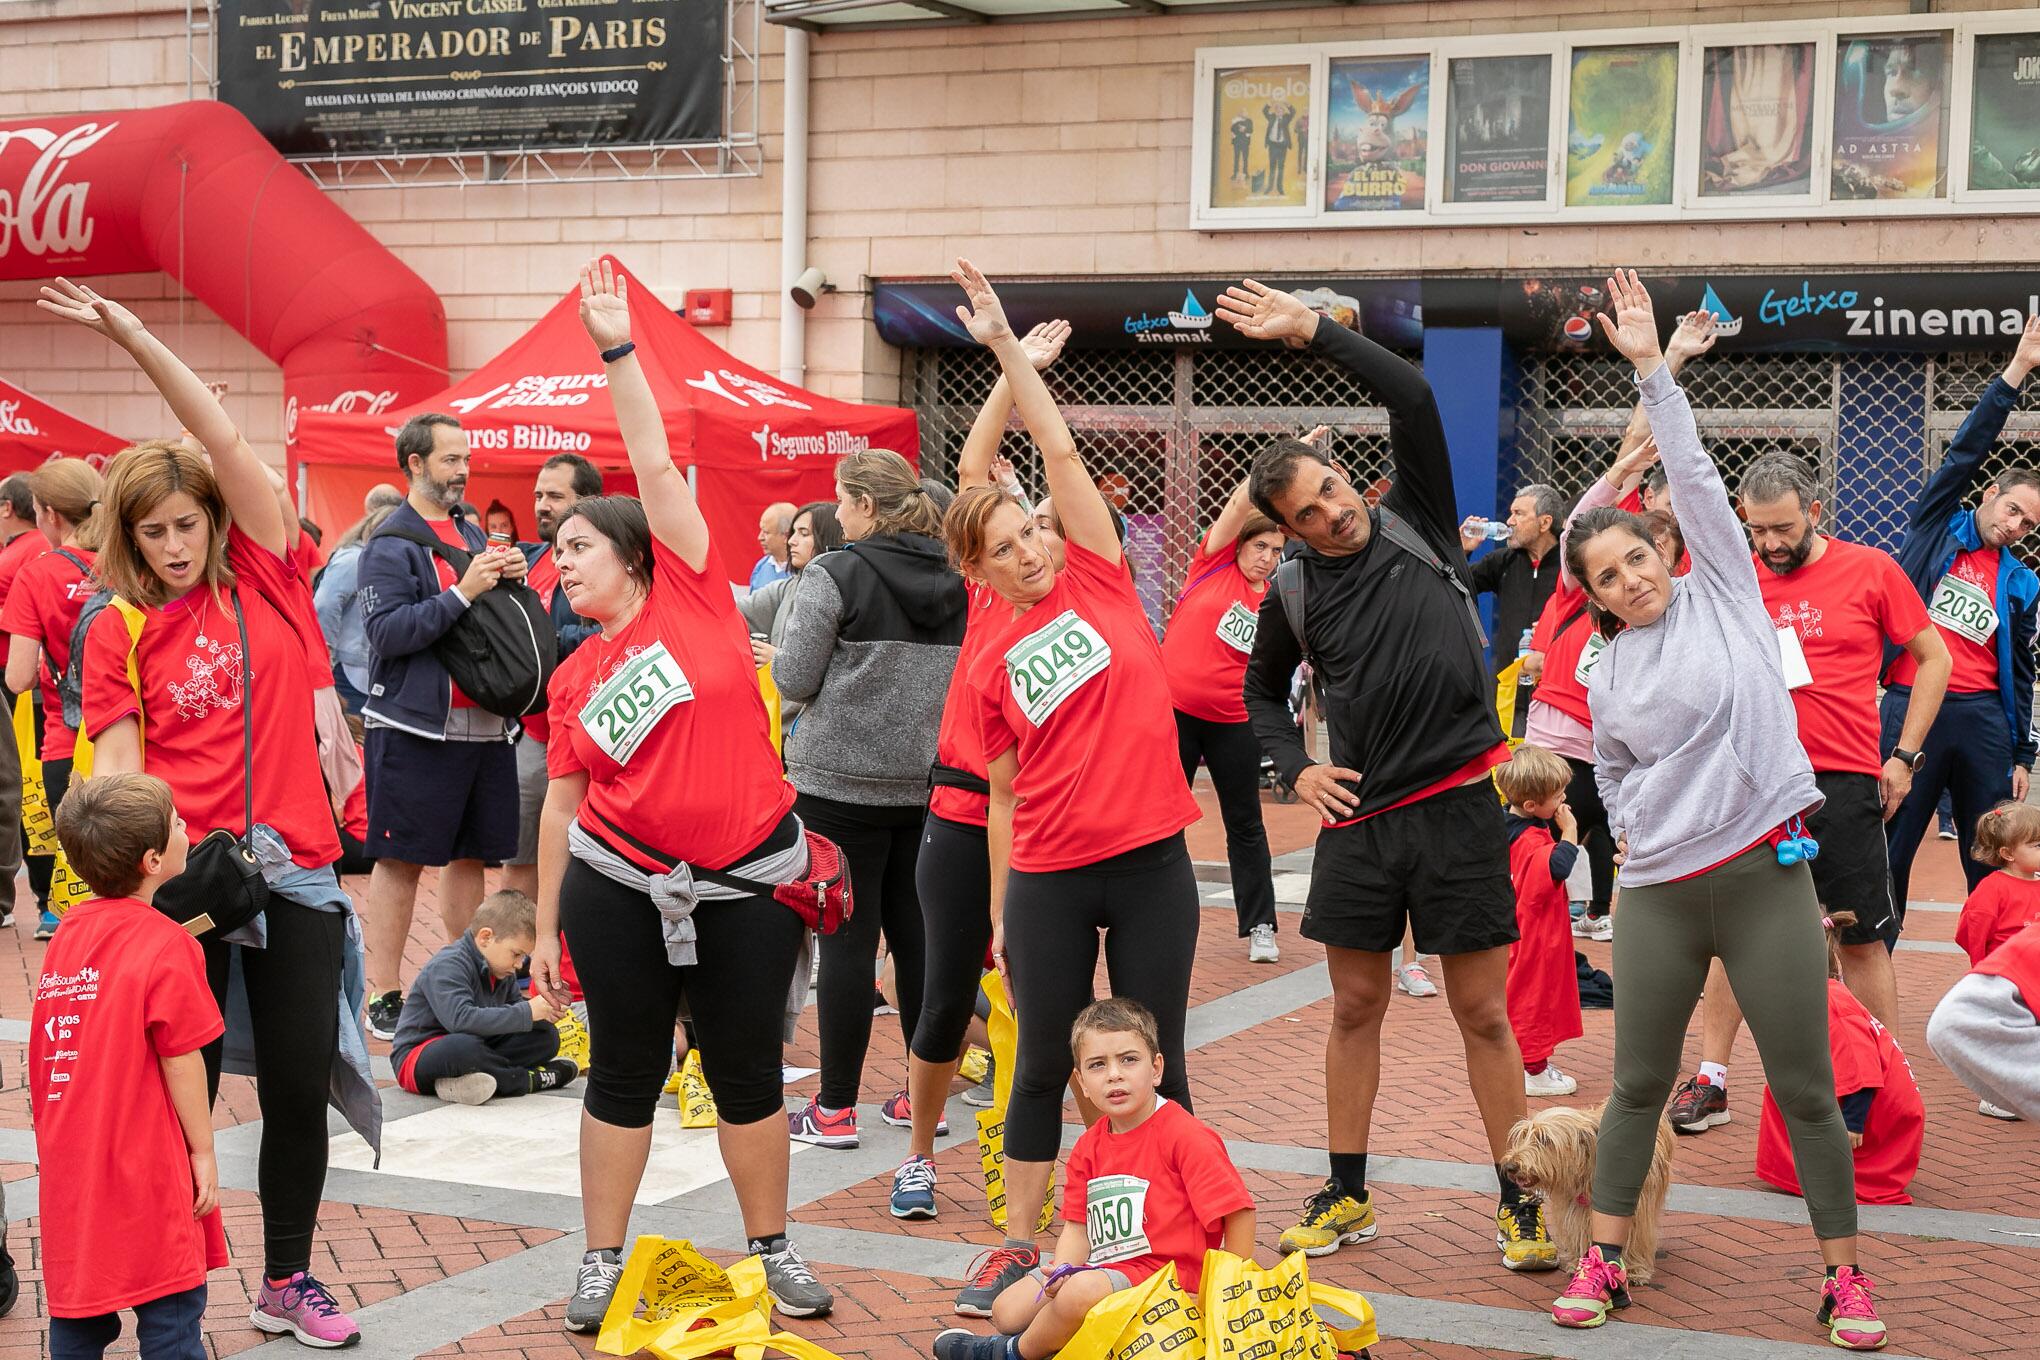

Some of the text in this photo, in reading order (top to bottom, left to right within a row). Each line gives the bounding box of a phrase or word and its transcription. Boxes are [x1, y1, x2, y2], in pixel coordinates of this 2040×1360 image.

[255, 16, 667, 73] EL EMPERADOR DE PARIS
[529, 81, 589, 98] FRANÇOIS
[590, 79, 639, 96] VIDOCQ
[1837, 143, 1922, 154] AD ASTRA
[1459, 162, 1487, 174] DON
[1758, 280, 1858, 328] Getxo
[1124, 312, 1169, 334] Getxo
[1135, 329, 1213, 343] zinemak
[513, 424, 592, 451] Bilbao
[771, 430, 870, 461] Seguros Bilbao
[66, 583, 78, 599] 7
[1936, 589, 1993, 631] 2036
[1224, 611, 1255, 647] 200
[1015, 630, 1092, 704] 2049
[597, 663, 671, 744] 2051
[988, 1170, 999, 1182] BM
[1158, 1299, 1177, 1316] BM
[1243, 1309, 1261, 1327] BM
[1131, 1334, 1151, 1353] BM
[1176, 1327, 1195, 1341] BM
[1223, 1340, 1232, 1351] M
[1255, 1341, 1273, 1356] BM
